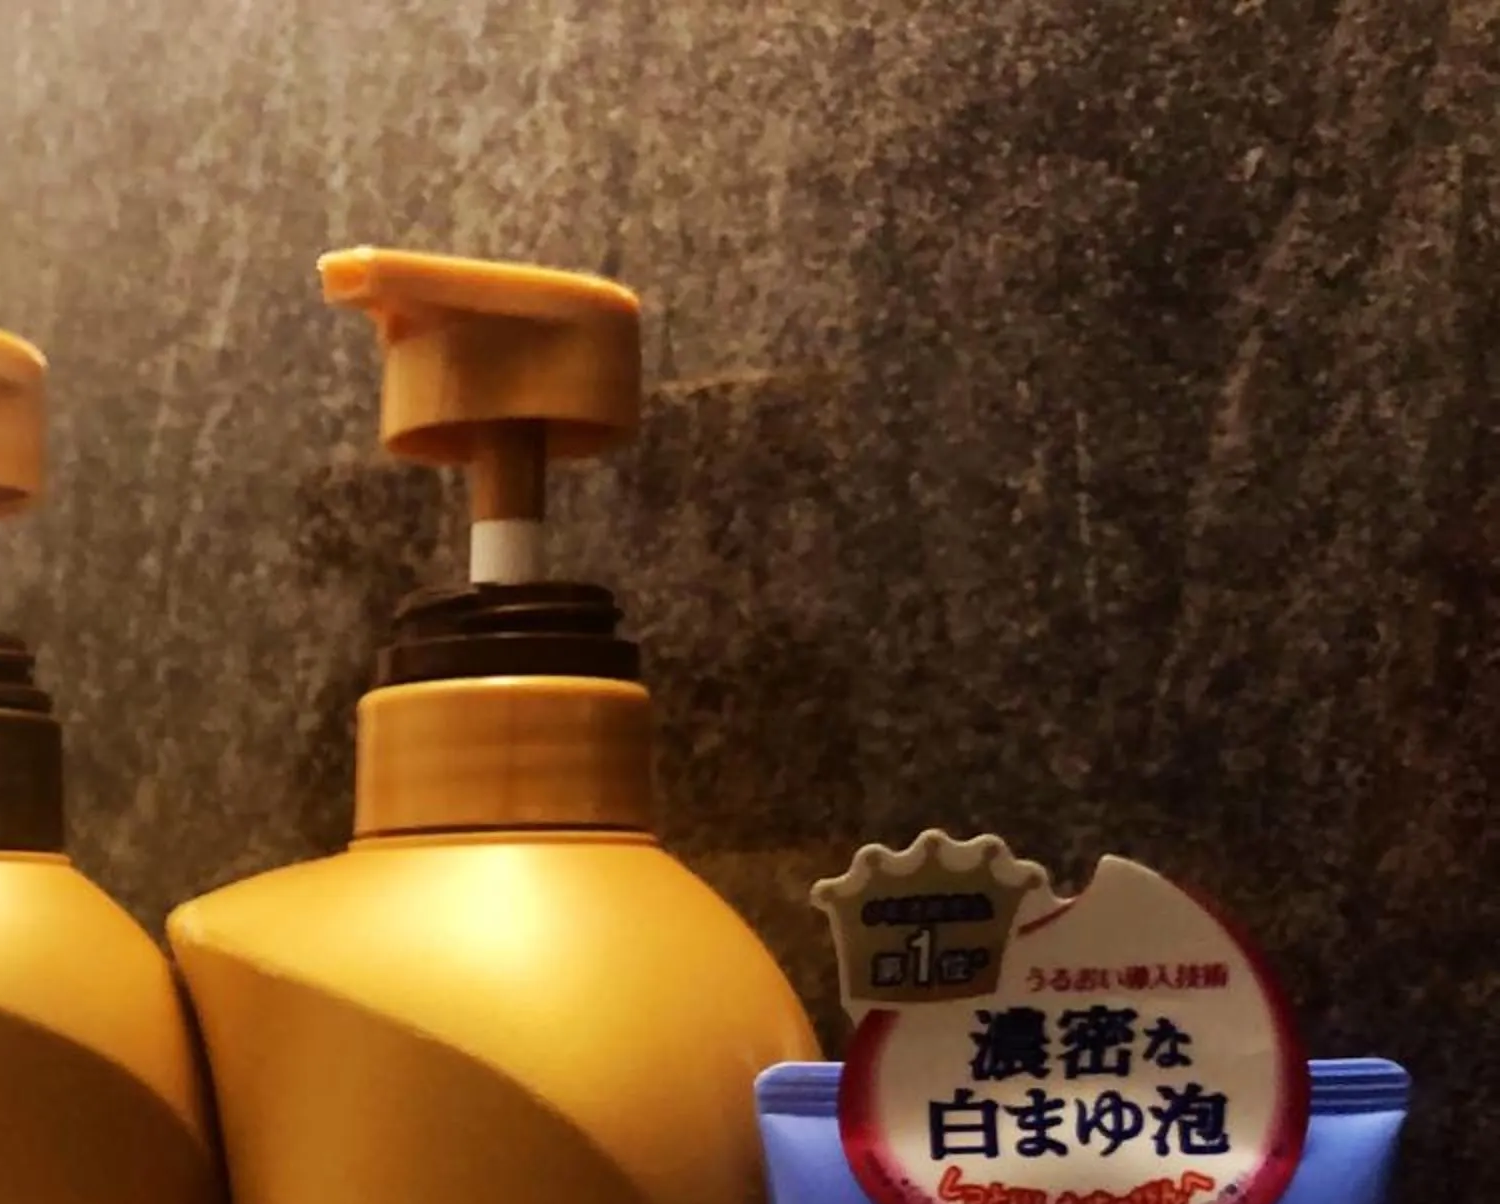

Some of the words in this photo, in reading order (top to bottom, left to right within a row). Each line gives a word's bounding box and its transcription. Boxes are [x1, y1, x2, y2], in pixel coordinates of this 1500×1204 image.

[969, 1005, 1193, 1080] 濃密な
[928, 1082, 1230, 1160] 白まゆ泡
